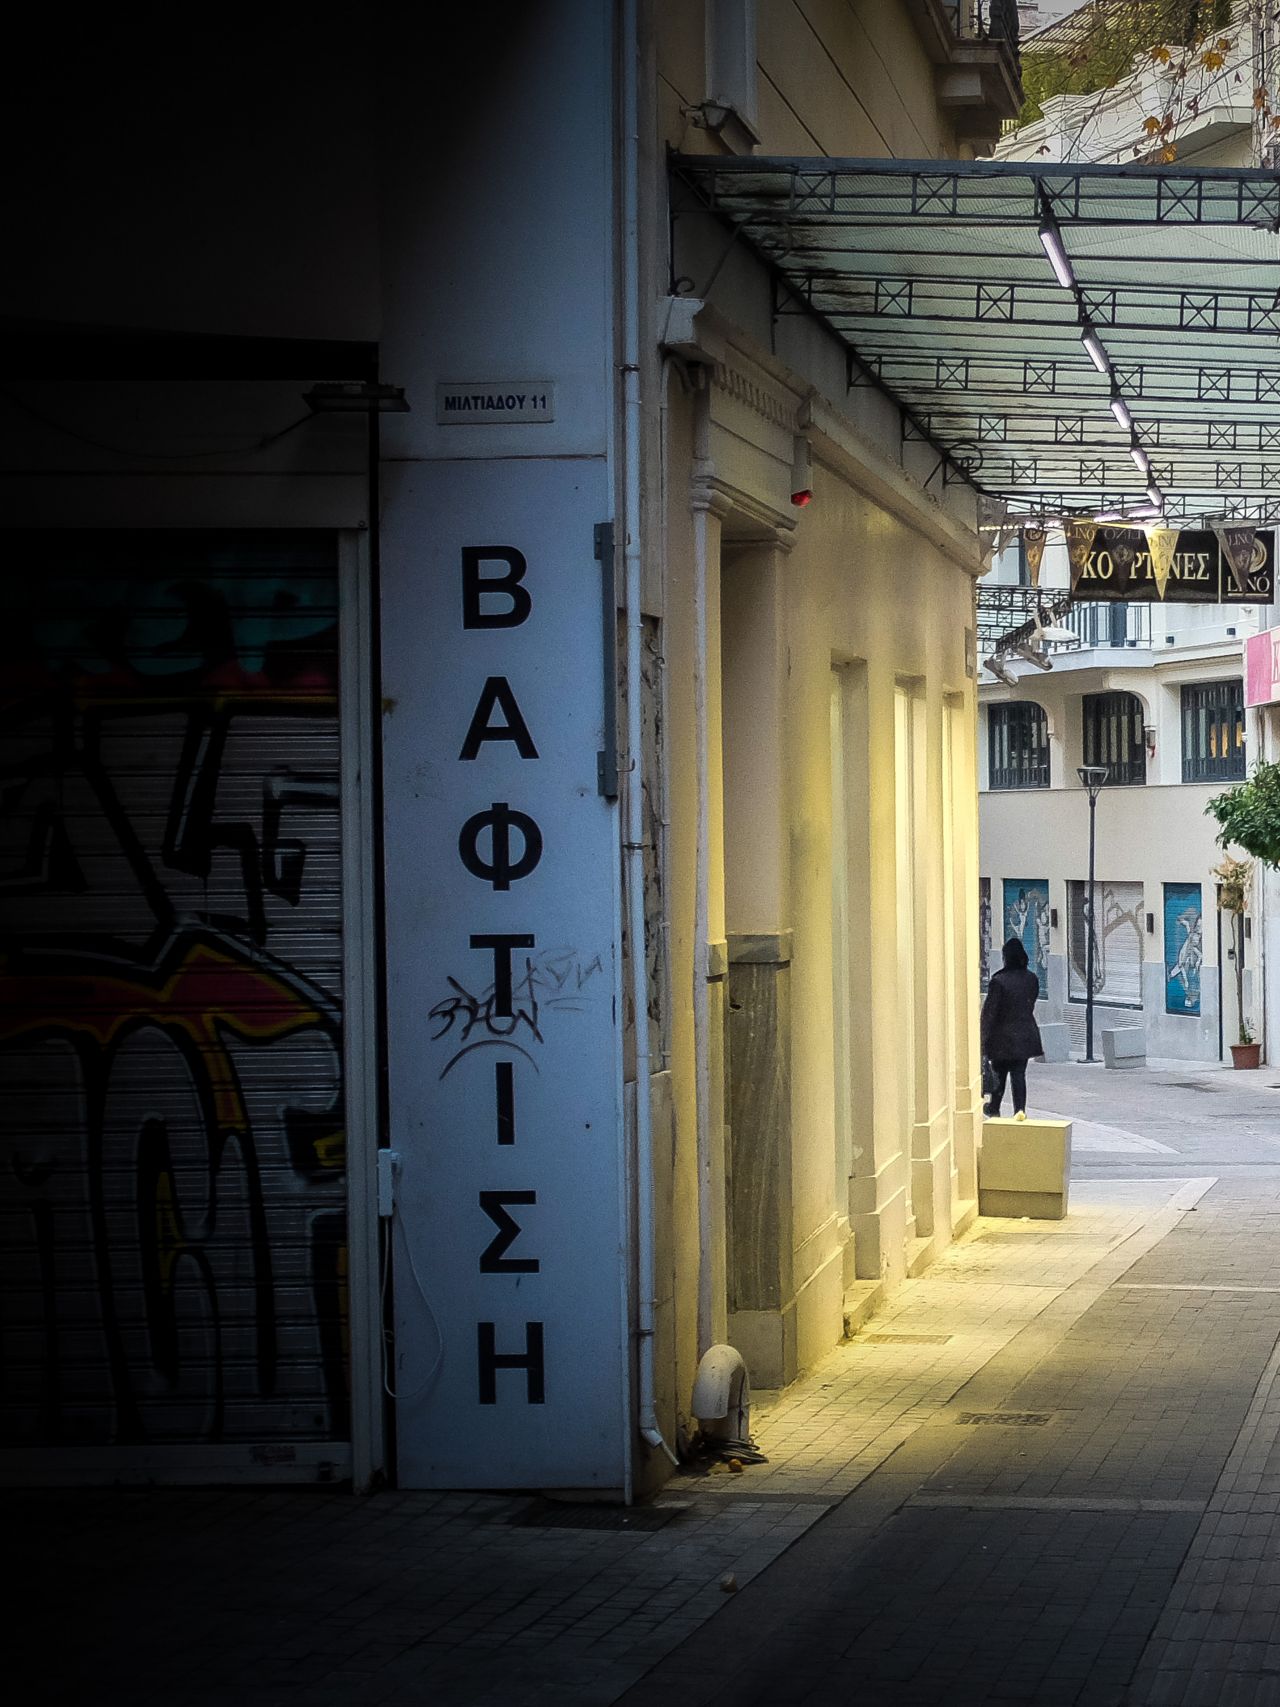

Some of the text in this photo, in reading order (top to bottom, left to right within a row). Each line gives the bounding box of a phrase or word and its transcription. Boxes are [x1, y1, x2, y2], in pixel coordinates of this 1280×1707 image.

[444, 394, 547, 410] ΜΙΛΤΙΑΔΟΥ 11
[1081, 551, 1210, 580] ΚΟΡΤΝΕΣ
[1227, 571, 1270, 593] LNÓ
[459, 545, 545, 1406] ΒΑΦΤΙΣΗ
